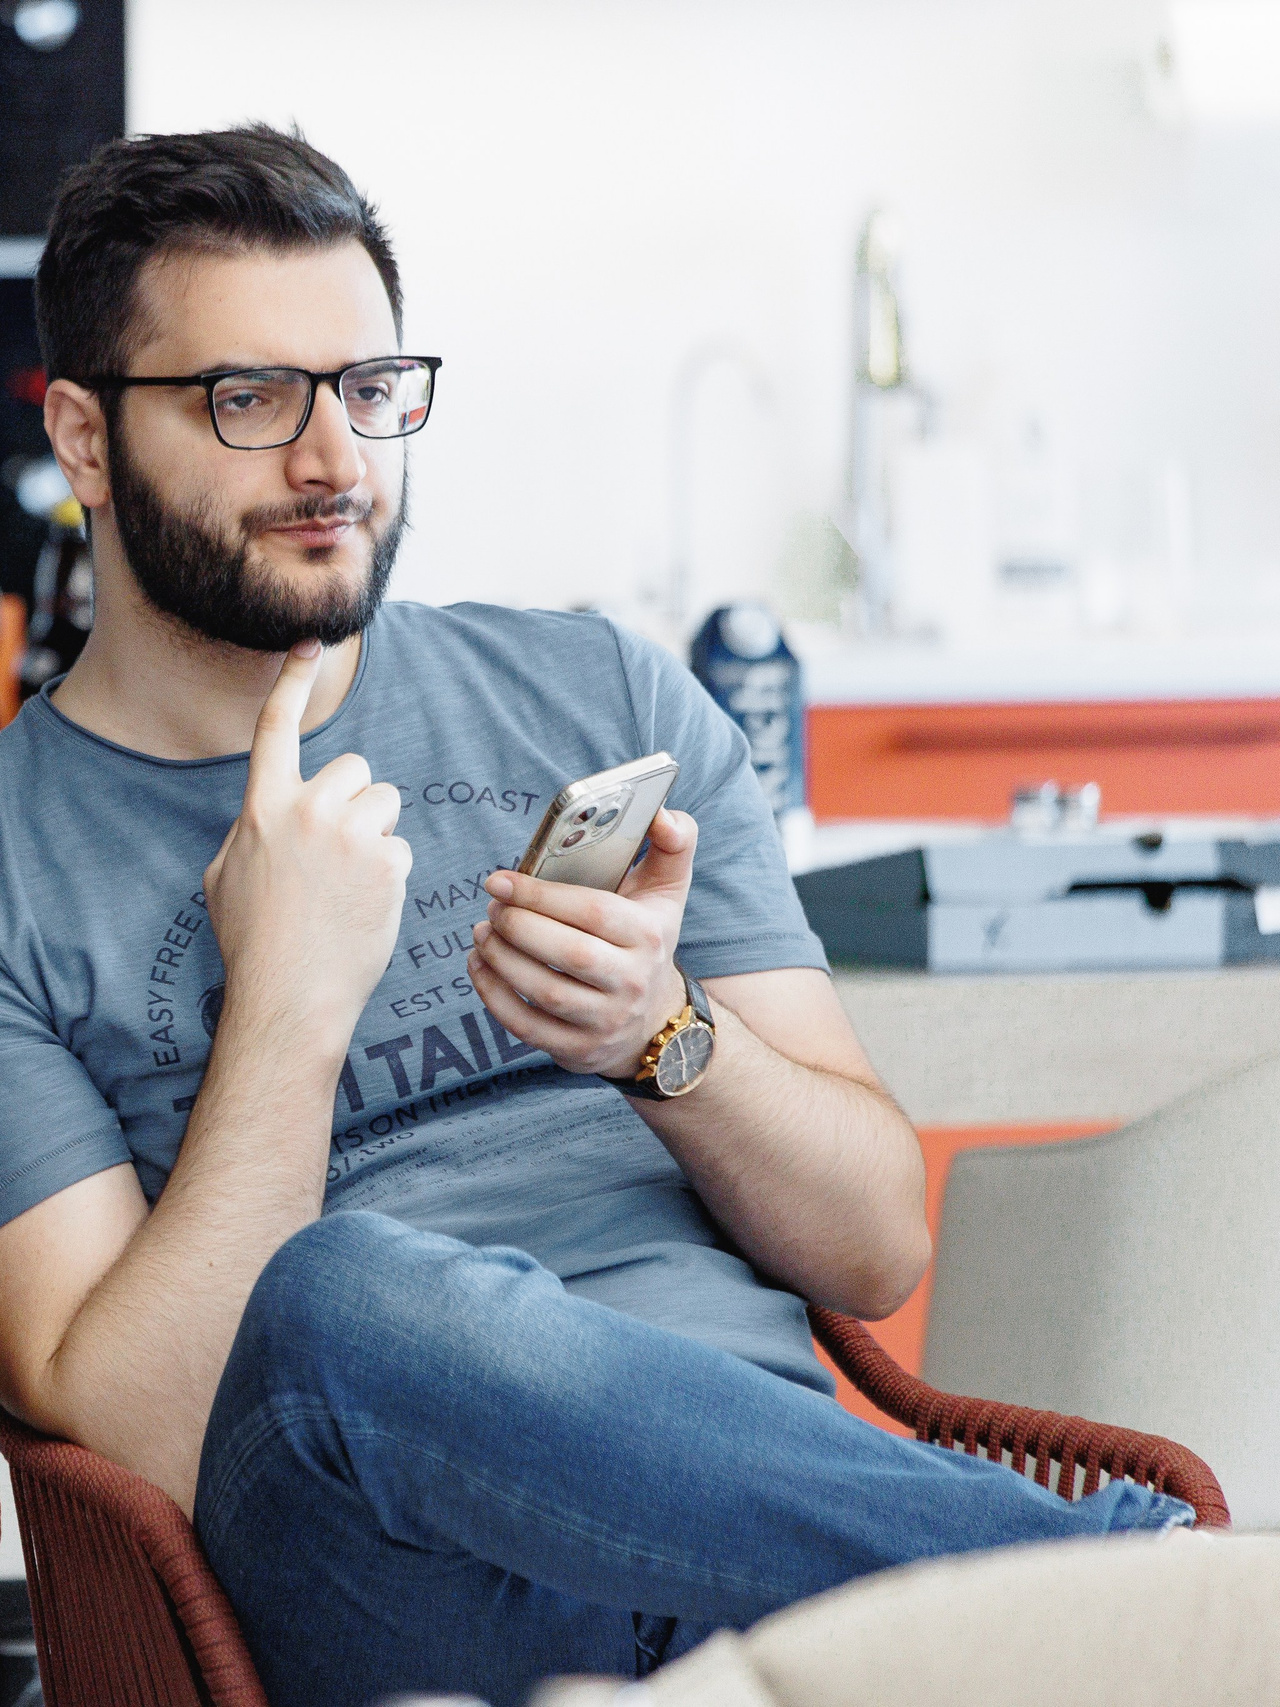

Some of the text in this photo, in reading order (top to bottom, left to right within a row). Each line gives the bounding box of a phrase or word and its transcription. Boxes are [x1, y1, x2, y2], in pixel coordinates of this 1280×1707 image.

[422, 781, 540, 816] COAST
[414, 855, 521, 919] MAX
[149, 909, 204, 987] FREE
[407, 922, 476, 970] FUL
[389, 985, 445, 1019] EST
[147, 989, 181, 1068] EASY
[368, 1102, 419, 1136] ON
